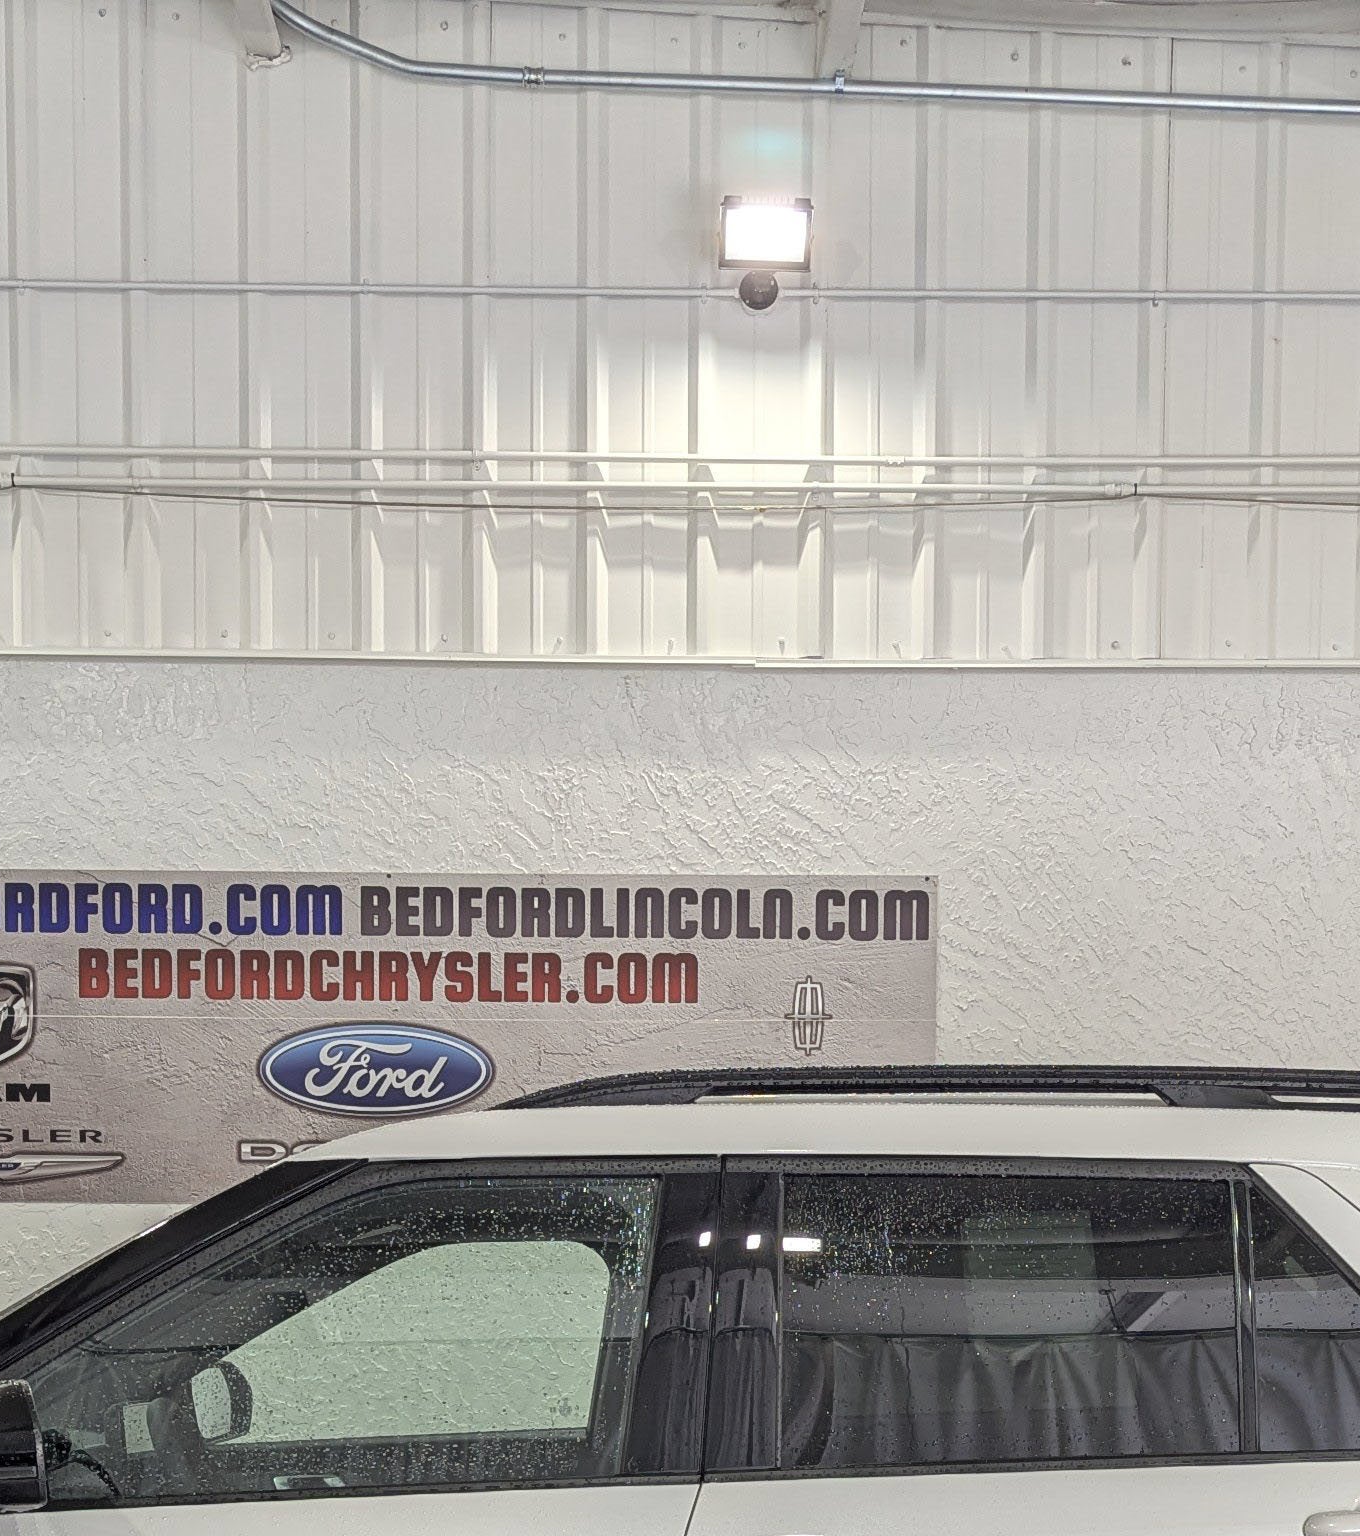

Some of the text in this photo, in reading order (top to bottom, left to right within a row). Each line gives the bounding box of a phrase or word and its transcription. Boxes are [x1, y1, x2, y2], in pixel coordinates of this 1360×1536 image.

[360, 885, 930, 941] BEDFORDLINCOLN.COM
[77, 947, 699, 1004] BEDFORDCHRYSLER.COM
[304, 1039, 449, 1099] Ford
